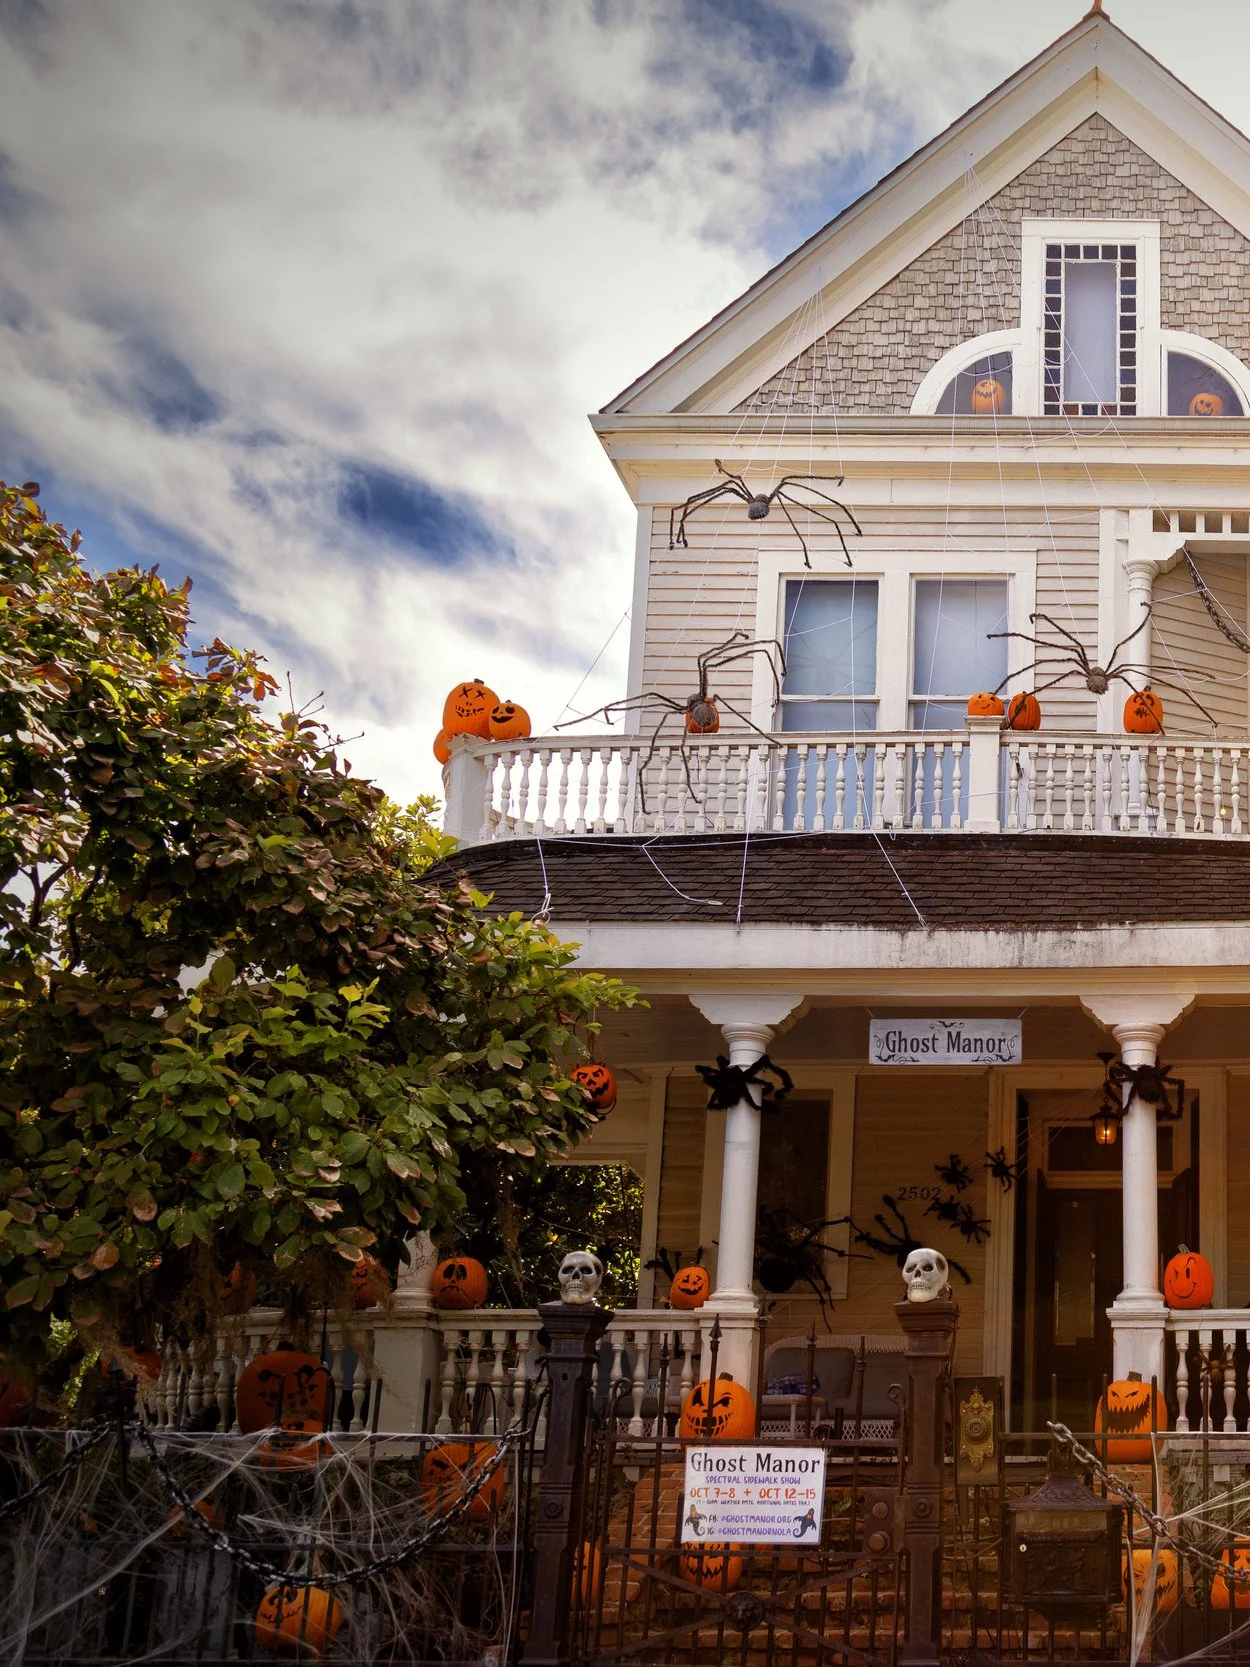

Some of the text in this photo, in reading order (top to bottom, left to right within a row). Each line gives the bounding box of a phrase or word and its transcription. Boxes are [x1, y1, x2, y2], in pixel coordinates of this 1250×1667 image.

[885, 1031, 1006, 1053] Ghost Manor
[897, 1187, 942, 1201] 2502
[691, 1452, 820, 1473] Ghost Manor
[706, 1476, 801, 1485] SPECTRAL SIDEWALK SHOW
[690, 1488, 710, 1498] OCT
[744, 1488, 752, 1497] +
[759, 1488, 781, 1499] OCT
[785, 1488, 817, 1500] 12-15
[708, 1515, 792, 1523] FB: @GHOSTMANOR.ORG
[718, 1527, 792, 1536] @GHOSTMANORNOLA
